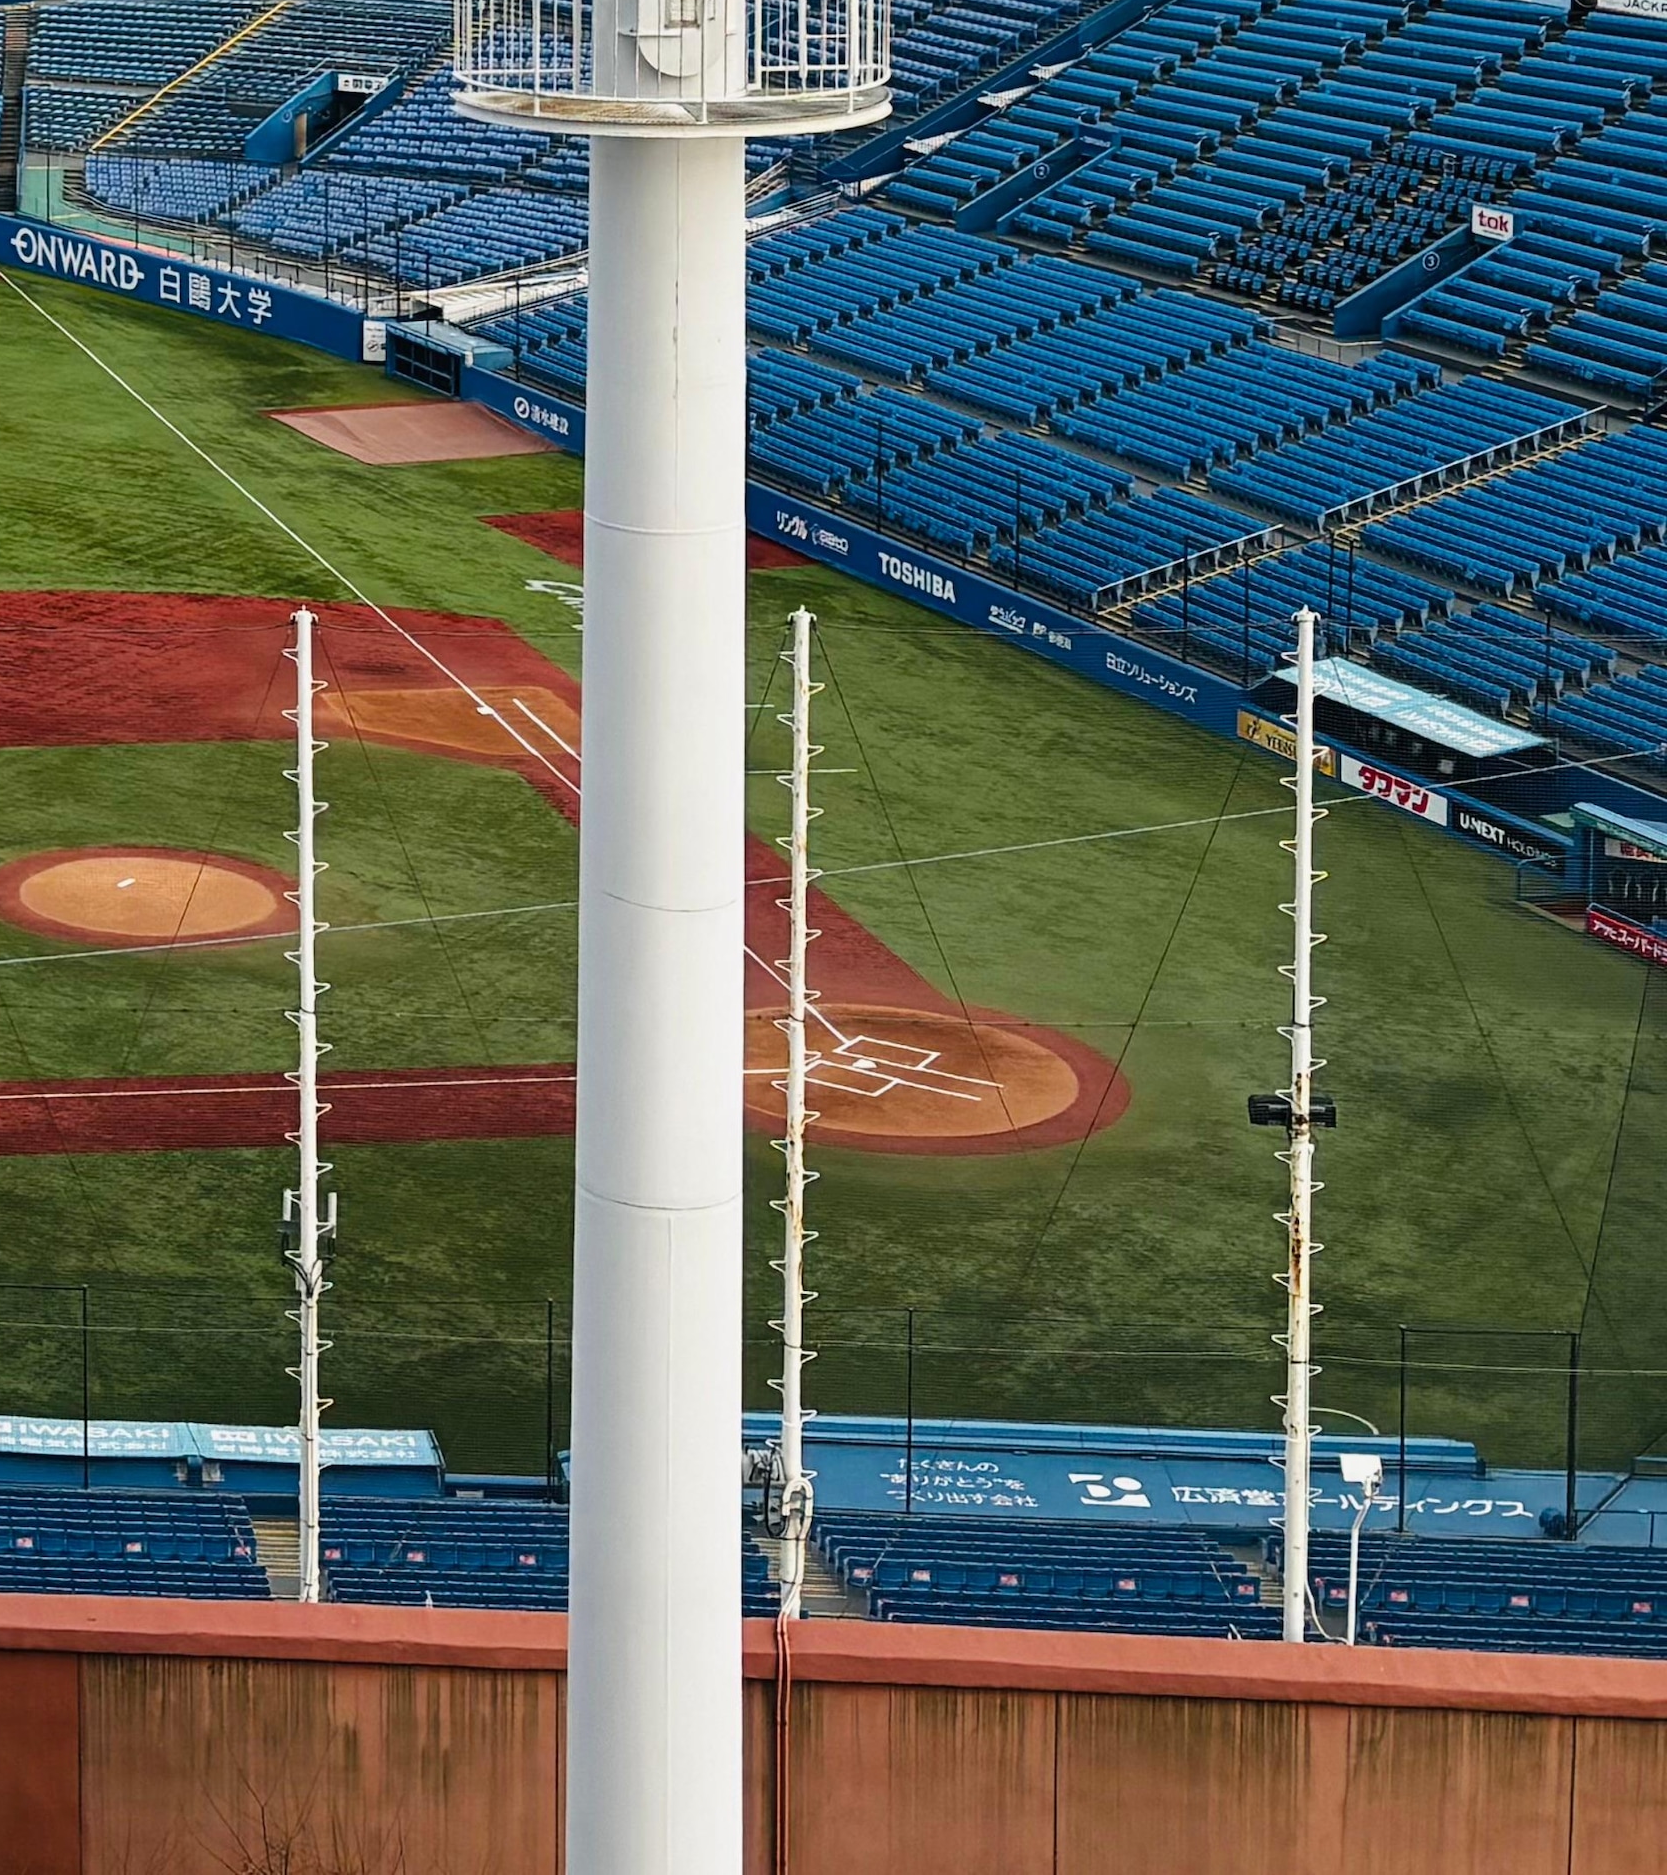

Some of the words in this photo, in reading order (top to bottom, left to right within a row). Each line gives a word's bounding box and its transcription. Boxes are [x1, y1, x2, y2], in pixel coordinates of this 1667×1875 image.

[1478, 210, 1509, 233] tok
[11, 228, 144, 291] ONWARD
[878, 552, 956, 603] TOSHIBA
[1106, 652, 1198, 704] 日立ソリューションズ
[1358, 766, 1429, 814] タフマン
[20, 1422, 169, 1438] IWASAKI
